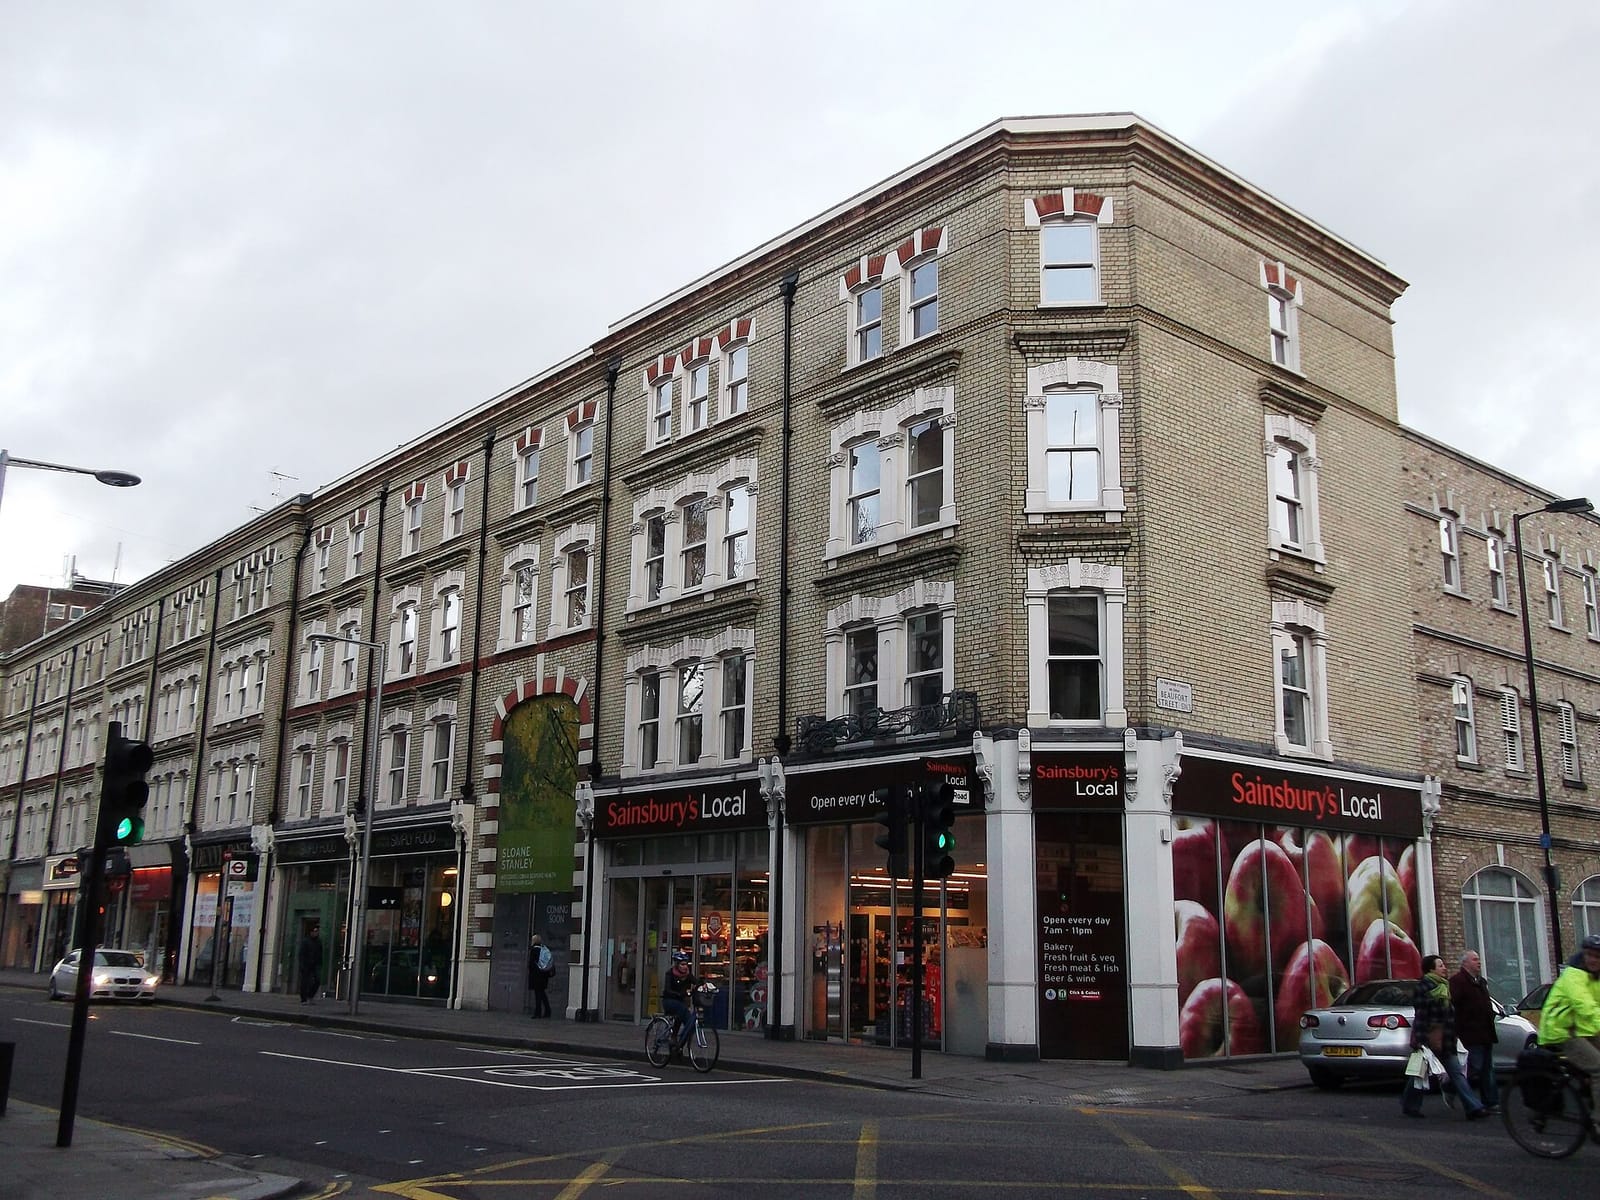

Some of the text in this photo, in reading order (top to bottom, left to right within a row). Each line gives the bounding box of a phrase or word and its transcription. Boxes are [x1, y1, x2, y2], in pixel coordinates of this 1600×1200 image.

[1160, 690, 1188, 703] BEAUFORT
[1158, 698, 1178, 708] STREET
[1036, 765, 1118, 781] Sainsbury's
[945, 774, 967, 786] Local
[1076, 780, 1118, 796] Local
[1231, 772, 1382, 820] Sainsbury's Local
[607, 788, 746, 827] Sainsbury's Local
[810, 796, 836, 811] Open
[838, 793, 866, 807] every
[502, 846, 531, 858] SLOANE
[501, 858, 534, 870] STANLEY
[546, 904, 569, 914] COMING
[549, 914, 565, 923] SOON
[1043, 916, 1111, 926] Open every day
[1043, 926, 1063, 934] 7am
[1072, 927, 1092, 935] 11pm
[1044, 942, 1074, 952] Bakery
[1044, 953, 1115, 963] Fresh fruit & veg
[1044, 963, 1119, 972] Fresh meat & fish
[1044, 974, 1097, 983] Beer & wine
